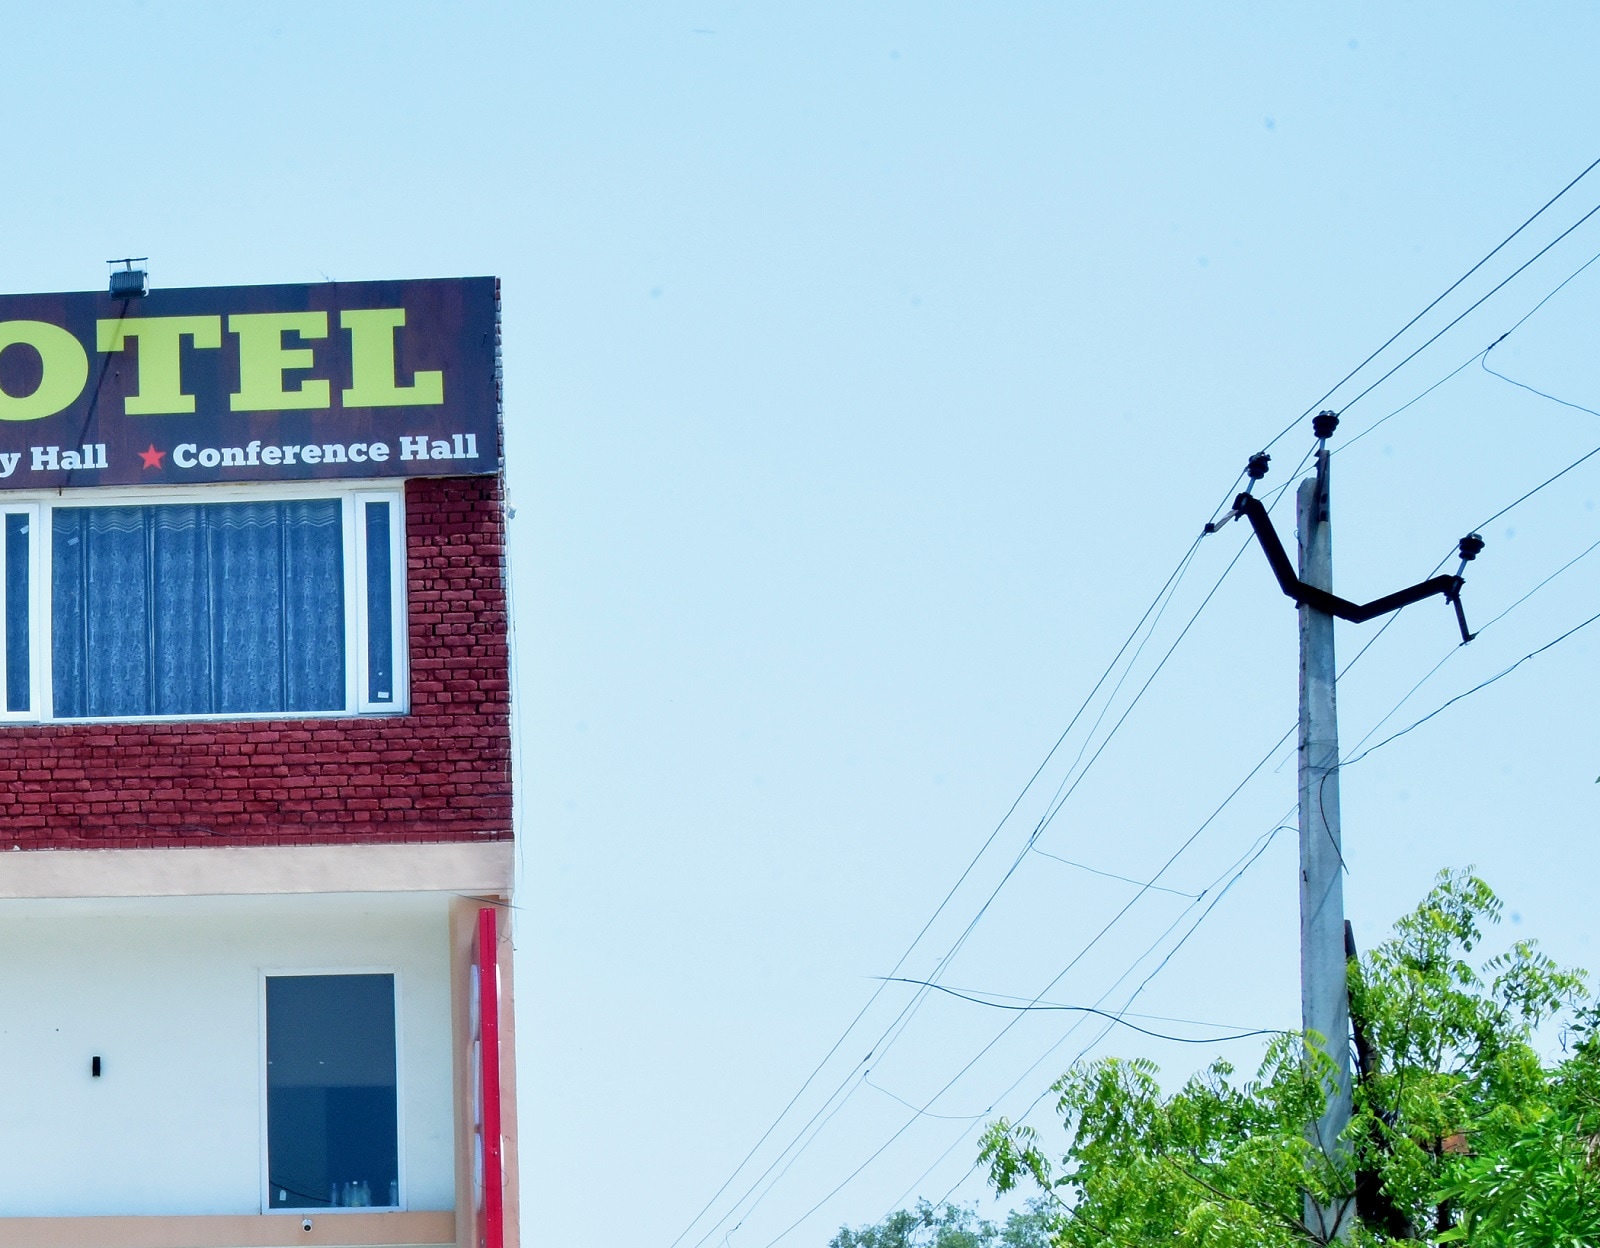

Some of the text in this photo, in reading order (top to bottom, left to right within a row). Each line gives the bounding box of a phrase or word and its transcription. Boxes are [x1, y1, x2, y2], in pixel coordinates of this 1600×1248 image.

[30, 443, 109, 471] Hall
[172, 433, 479, 469] Conference Hall
